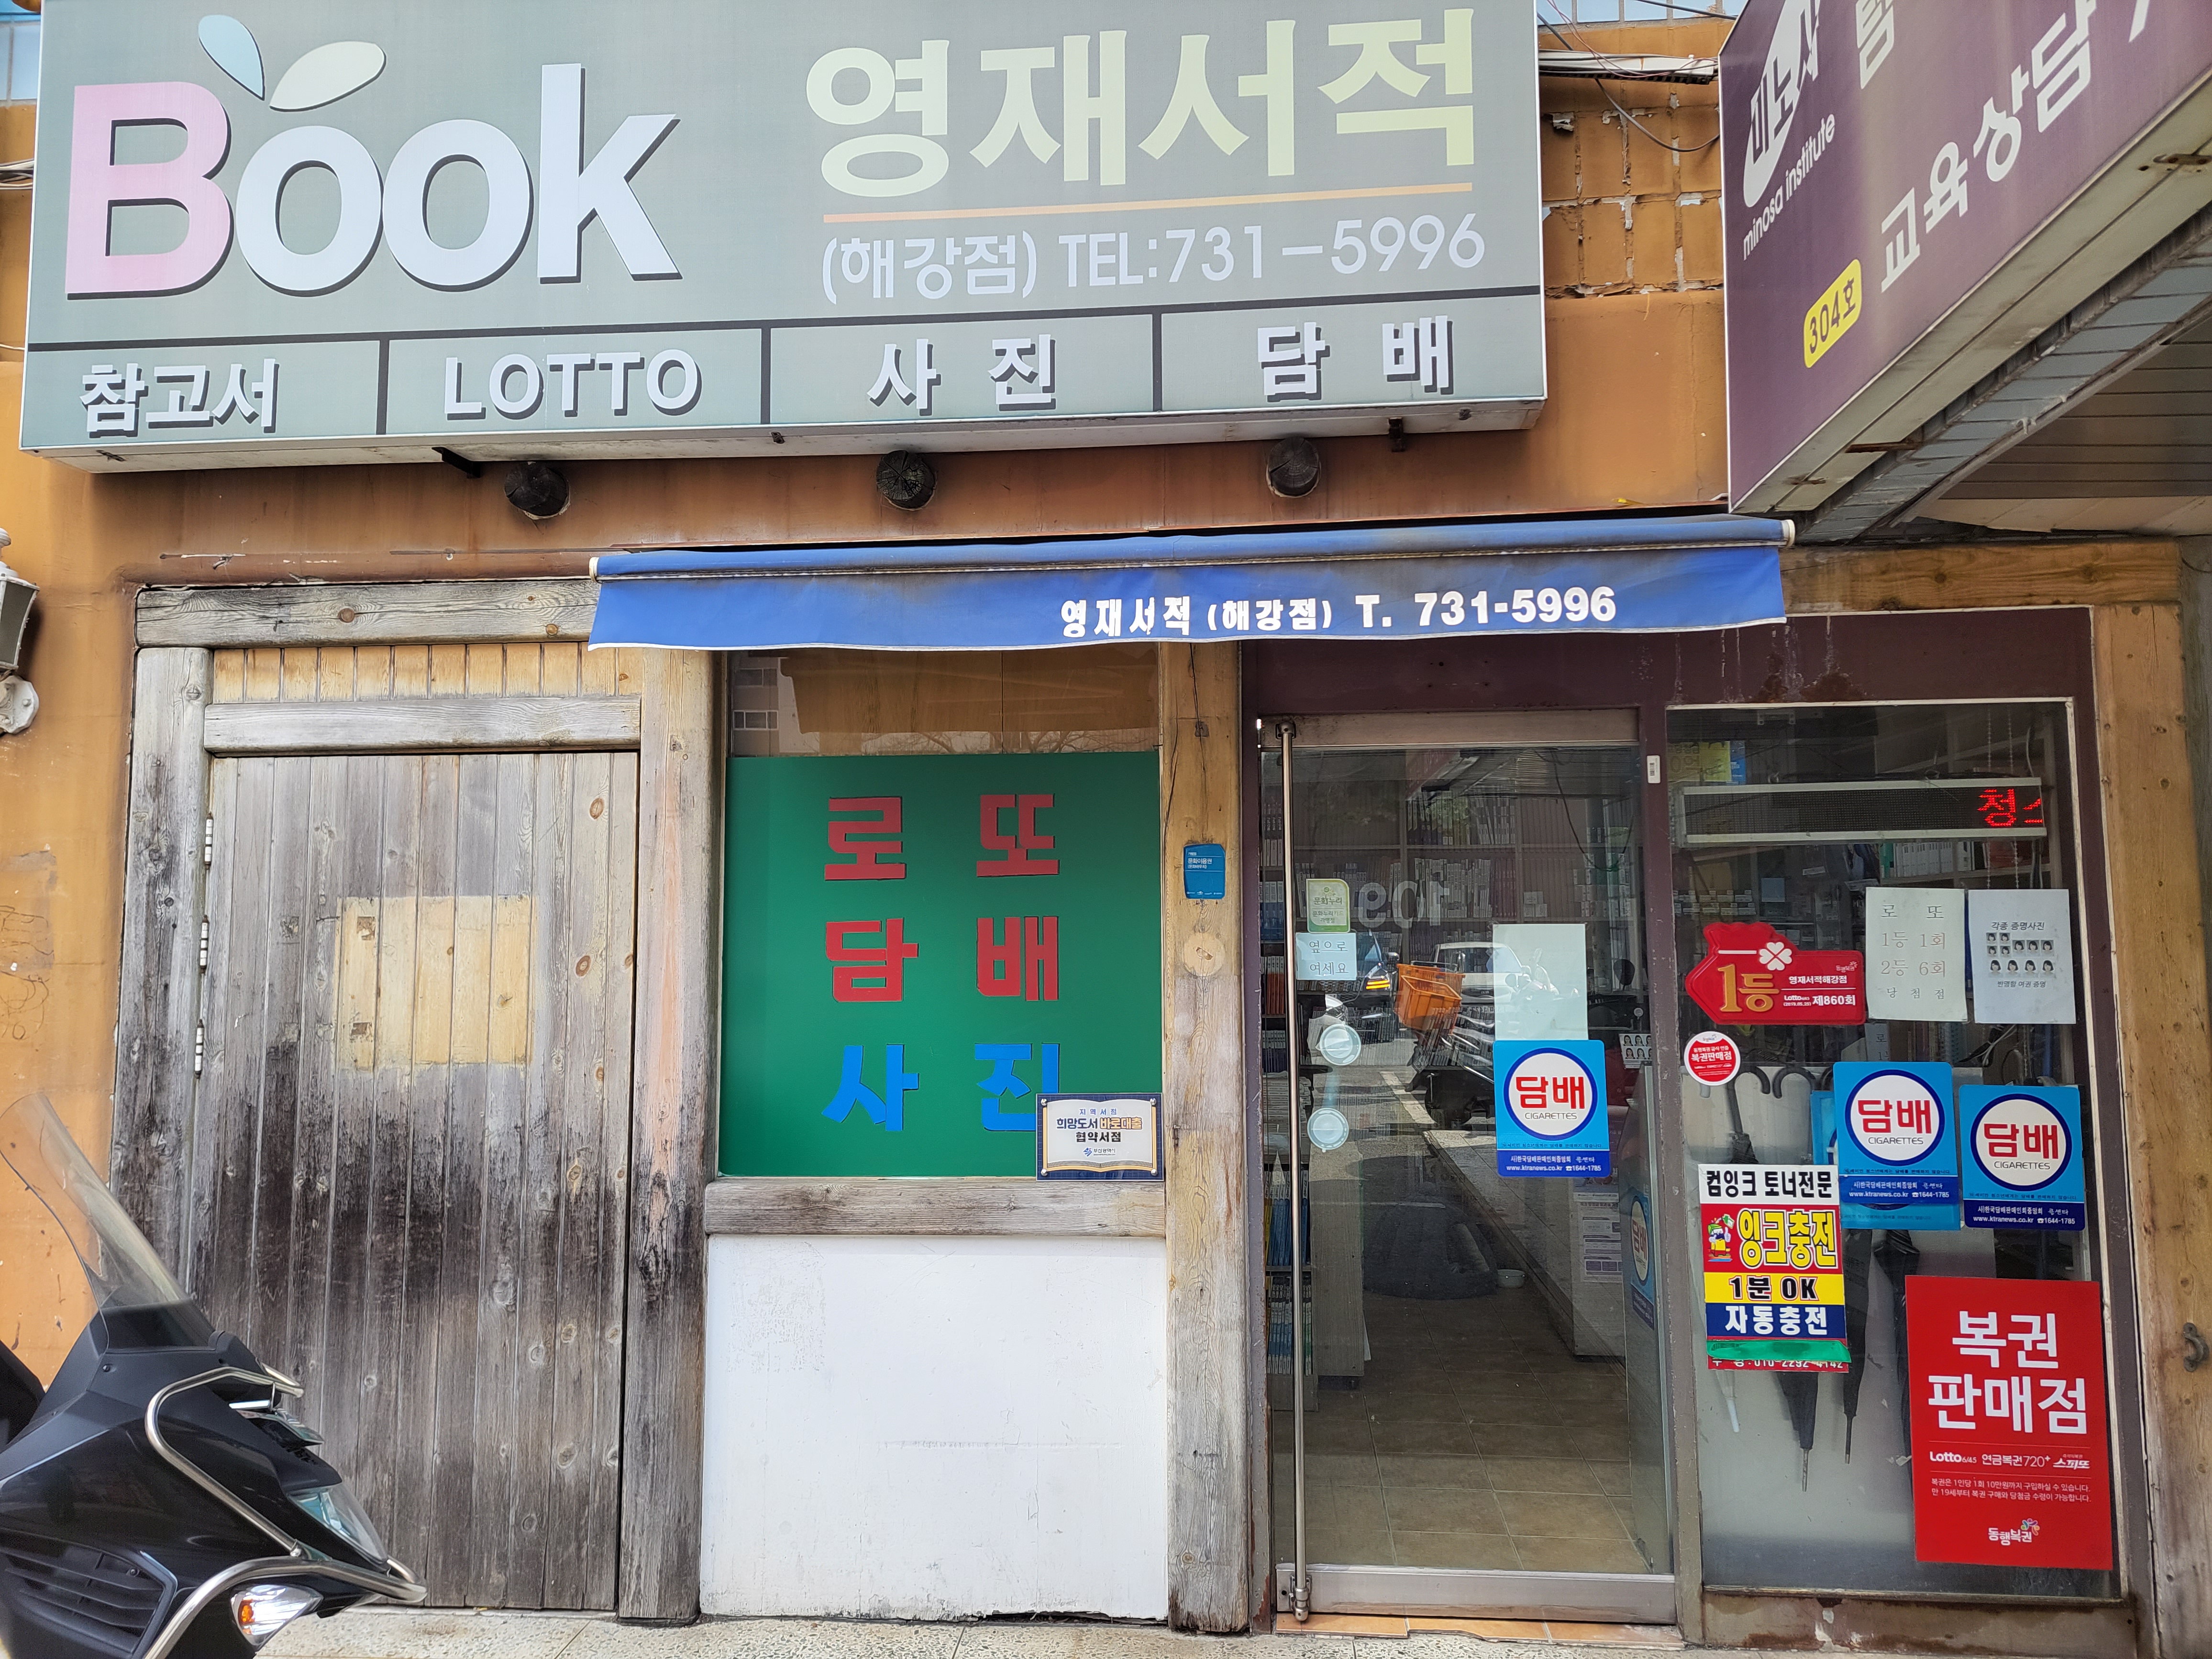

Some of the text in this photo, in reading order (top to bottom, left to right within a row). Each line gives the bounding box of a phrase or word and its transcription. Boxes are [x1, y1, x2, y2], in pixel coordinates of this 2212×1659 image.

[806, 8, 1474, 198] 영재서적
[66, 63, 682, 299] Book
[1744, 114, 1836, 261] minosa institute
[822, 235, 1038, 304] (해강점)
[1809, 277, 1856, 354] 304호
[80, 358, 279, 439] 참고서
[445, 349, 703, 420] LOTTO
[1060, 586, 1617, 639] 영재서적 (해강점) T. 731-5996
[1313, 895, 1342, 905] 문화누리
[1991, 921, 2045, 930] 각종 증명사진
[1309, 940, 1349, 953] 옆으로
[1309, 962, 1349, 975] 여세요
[1789, 975, 1847, 984] 영재서적해강점
[1717, 963, 1780, 1012] 1등
[1812, 995, 1856, 1006] 제860회
[1515, 1076, 1585, 1109] 담배
[1056, 1117, 1142, 1130] 희망도서 바로대출
[1857, 1099, 1932, 1134] 담배
[1075, 1131, 1122, 1143] 협약서점
[1868, 1137, 1924, 1145] CIGARETTES
[1983, 1123, 2058, 1160] 담배
[1994, 1161, 2050, 1170] CIGARETTES
[1706, 1170, 1832, 1198] 컴잉크 토너전문
[1738, 1208, 1838, 1269] 잉크충전
[1728, 1275, 1819, 1301] 1분 OK
[1725, 1305, 1827, 1336] 자동충전
[1952, 1311, 2058, 1368] 복권
[1928, 1373, 2087, 1435] 판매점
[1931, 1478, 1952, 1486] 복권은
[1954, 1479, 1971, 1487] 1인당
[1974, 1480, 1985, 1488] 1회
[1986, 1481, 2023, 1490] 10만원까지
[2023, 1482, 2051, 1491] 구입하실
[1931, 1488, 1939, 1496] 만
[1941, 1489, 1970, 1498] 19세부터
[1971, 1490, 1986, 1498] 복권
[1987, 1491, 2009, 1500] 구매와
[2009, 1492, 2031, 1500] 당첨금
[2032, 1493, 2053, 1501] 수령이
[1988, 1527, 2033, 1546] 동행복권
